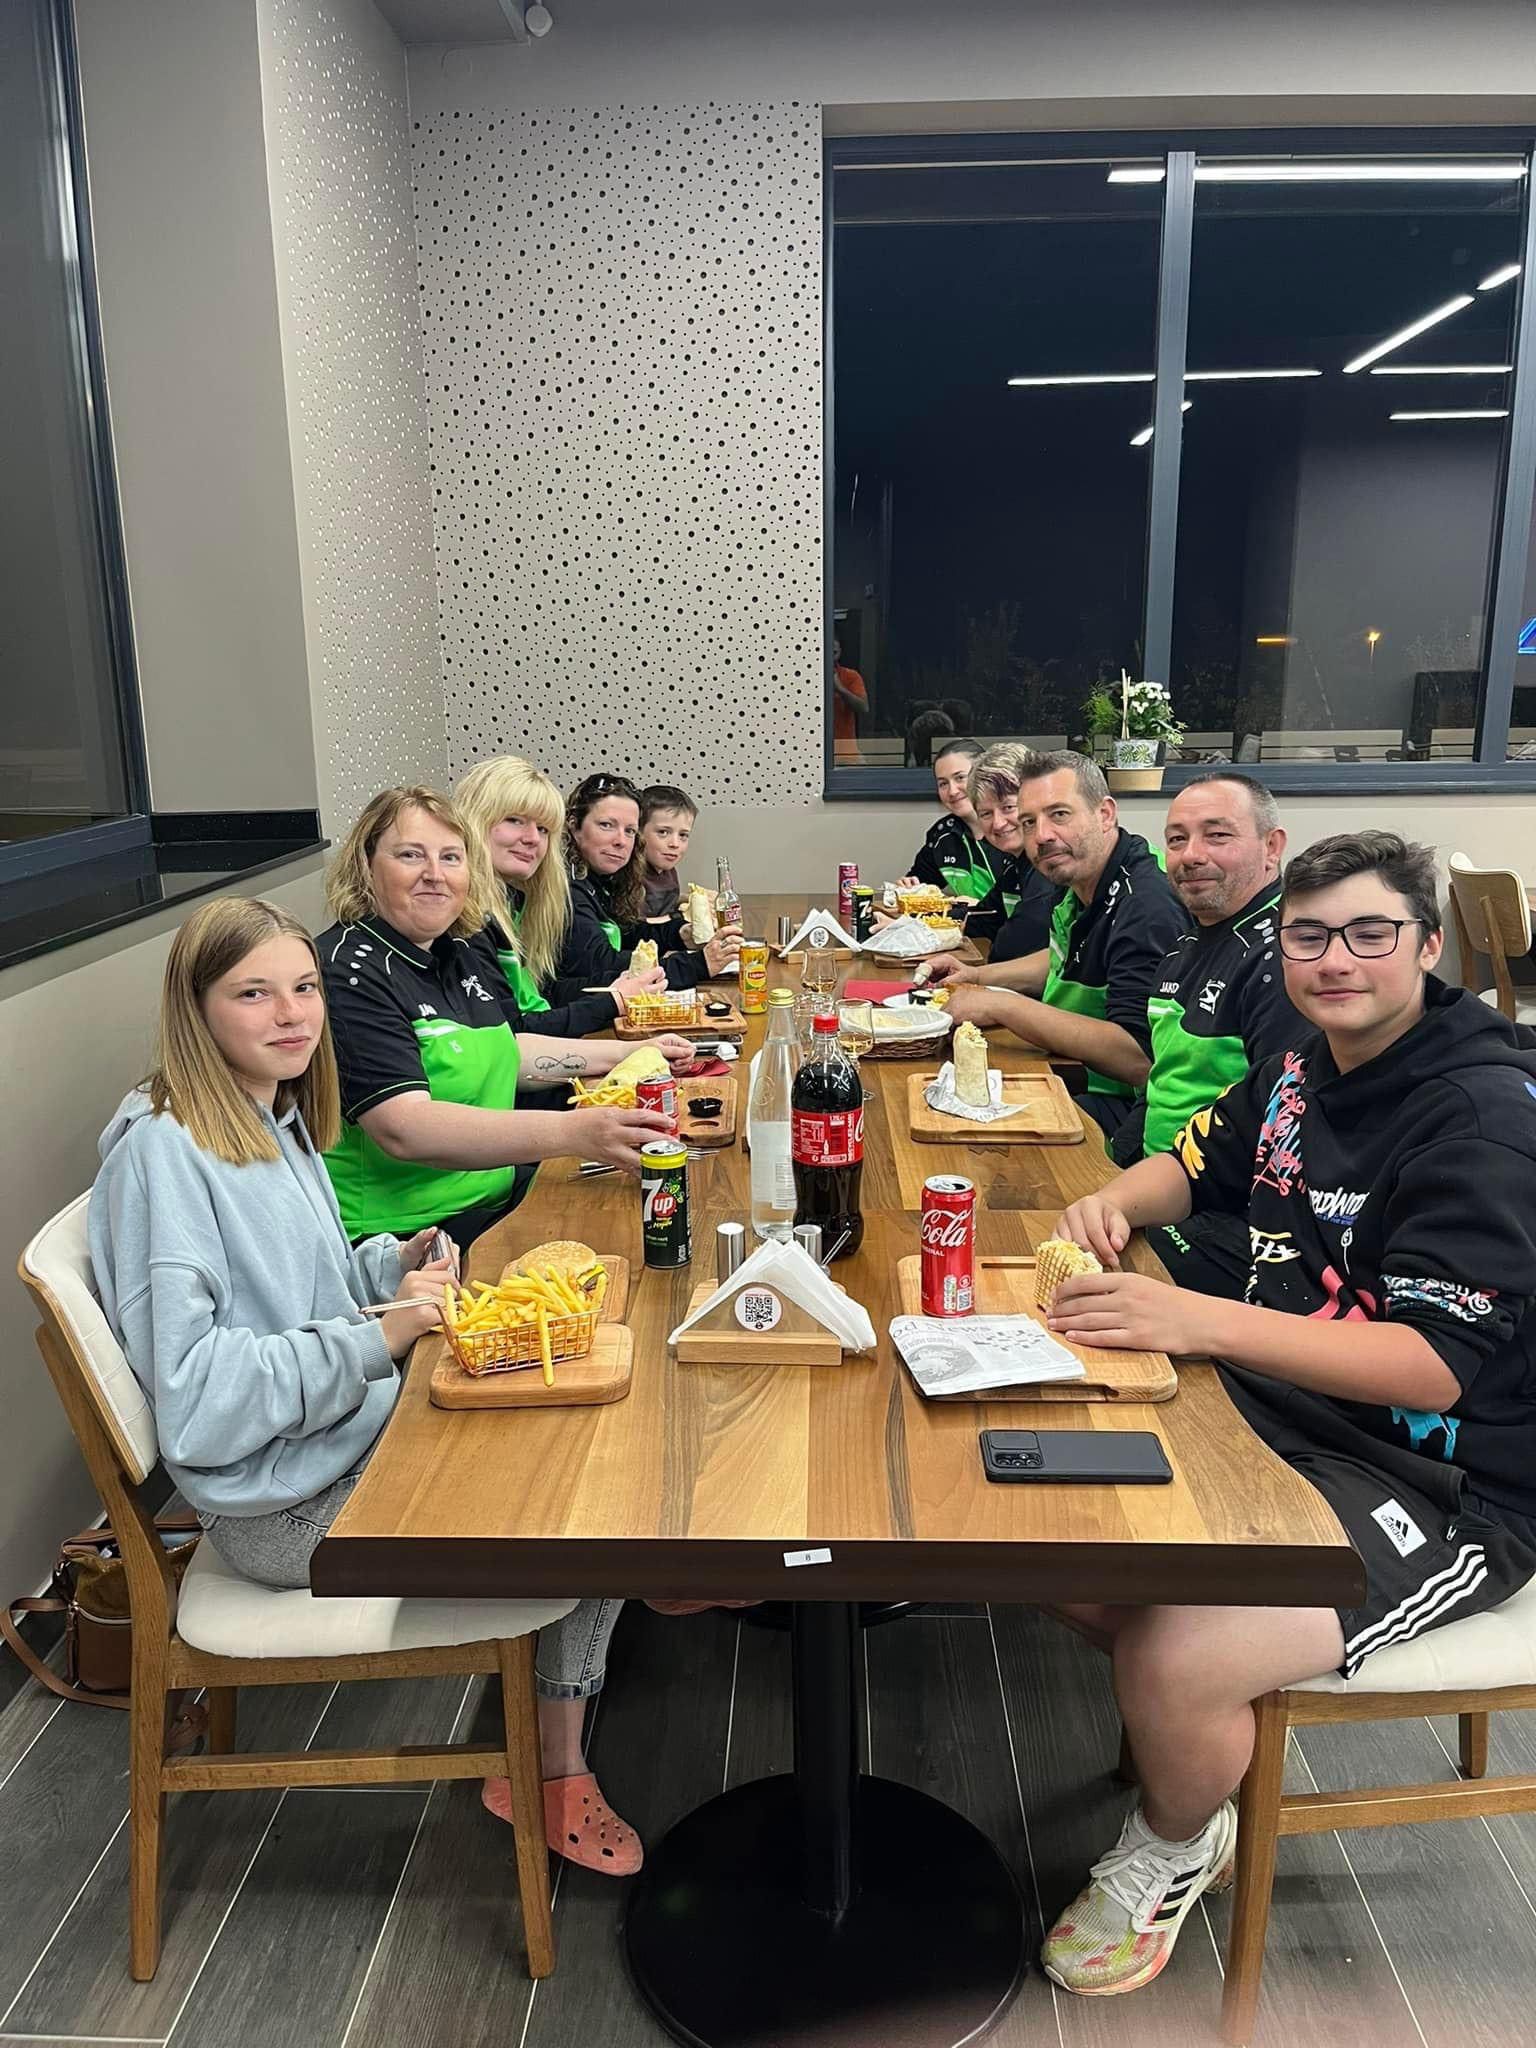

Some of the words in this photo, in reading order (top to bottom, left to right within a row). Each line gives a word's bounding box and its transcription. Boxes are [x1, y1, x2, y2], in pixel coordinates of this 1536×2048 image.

[922, 1208, 972, 1247] Cola
[1162, 1224, 1191, 1253] port
[1380, 1513, 1407, 1548] adidas
